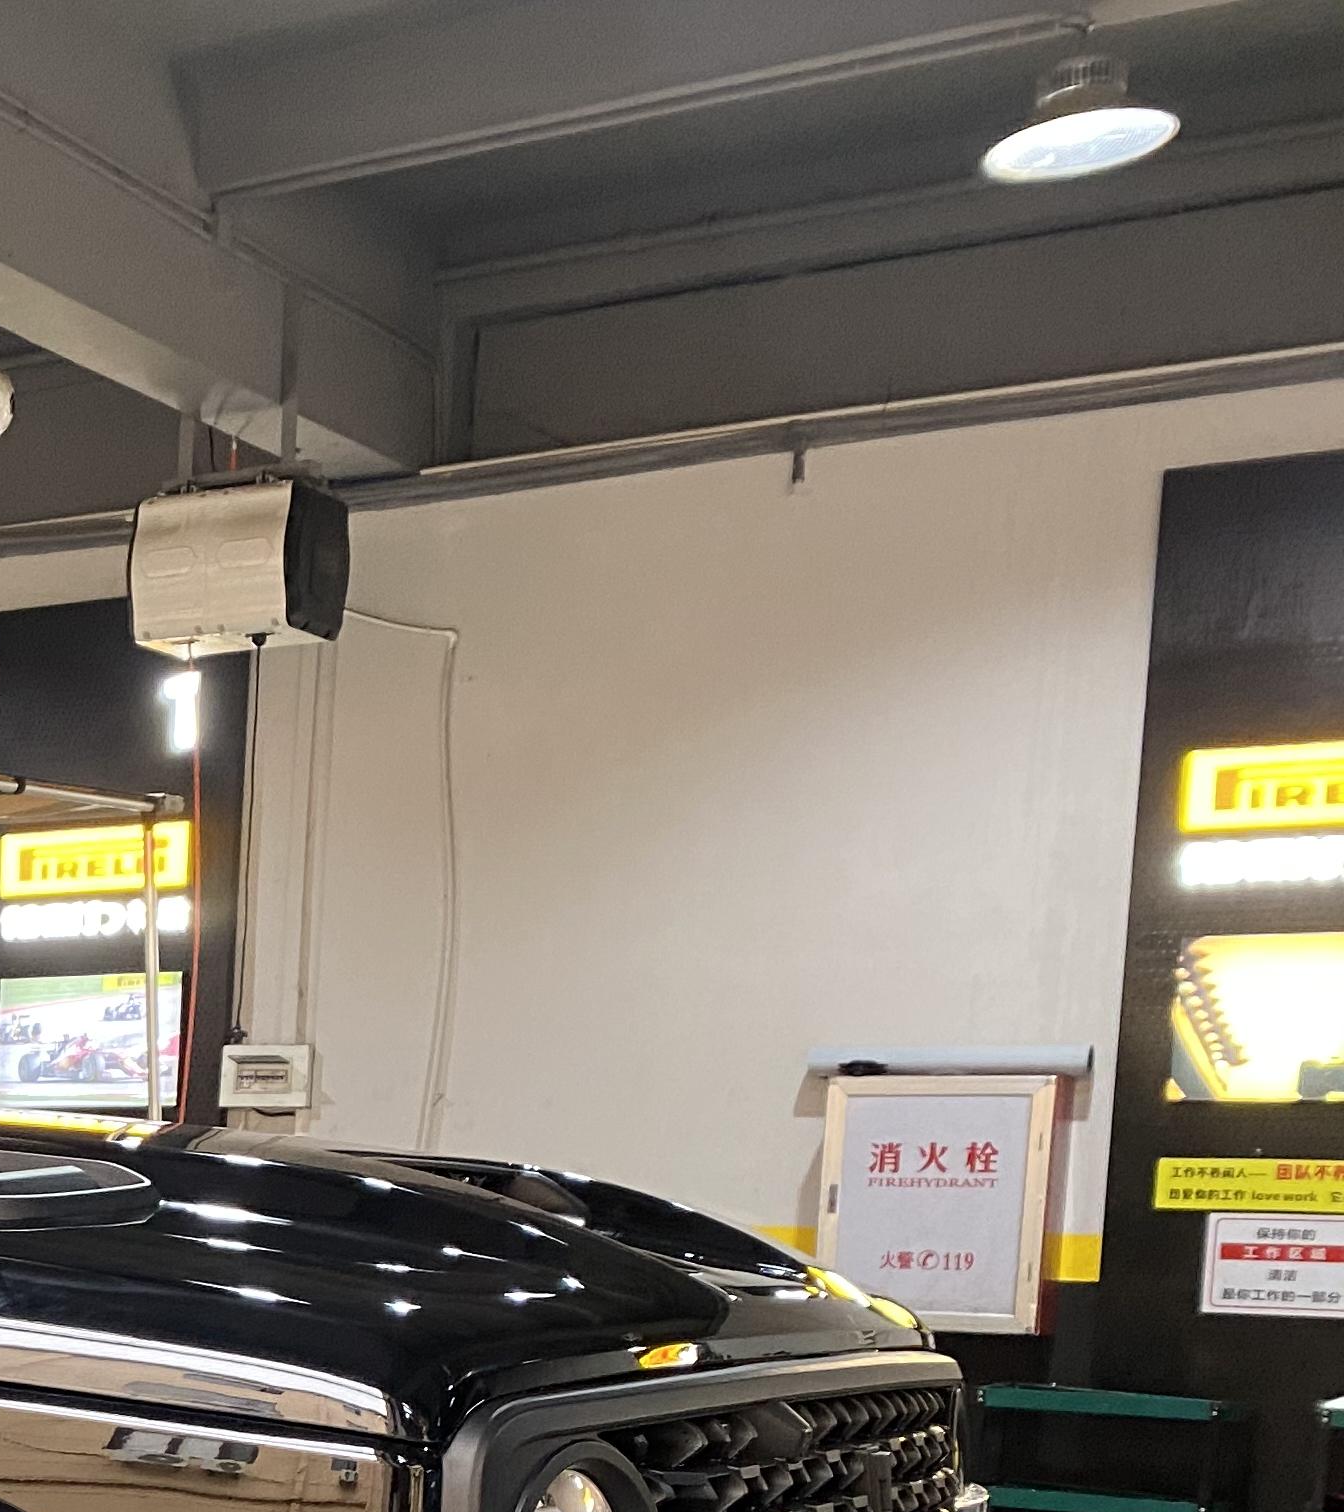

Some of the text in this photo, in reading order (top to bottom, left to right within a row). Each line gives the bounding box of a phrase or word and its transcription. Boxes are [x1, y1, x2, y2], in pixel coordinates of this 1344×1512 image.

[869, 1142, 999, 1173] 消火栓
[868, 1178, 998, 1188] FIREHYDRANT
[943, 1252, 974, 1271] 119
